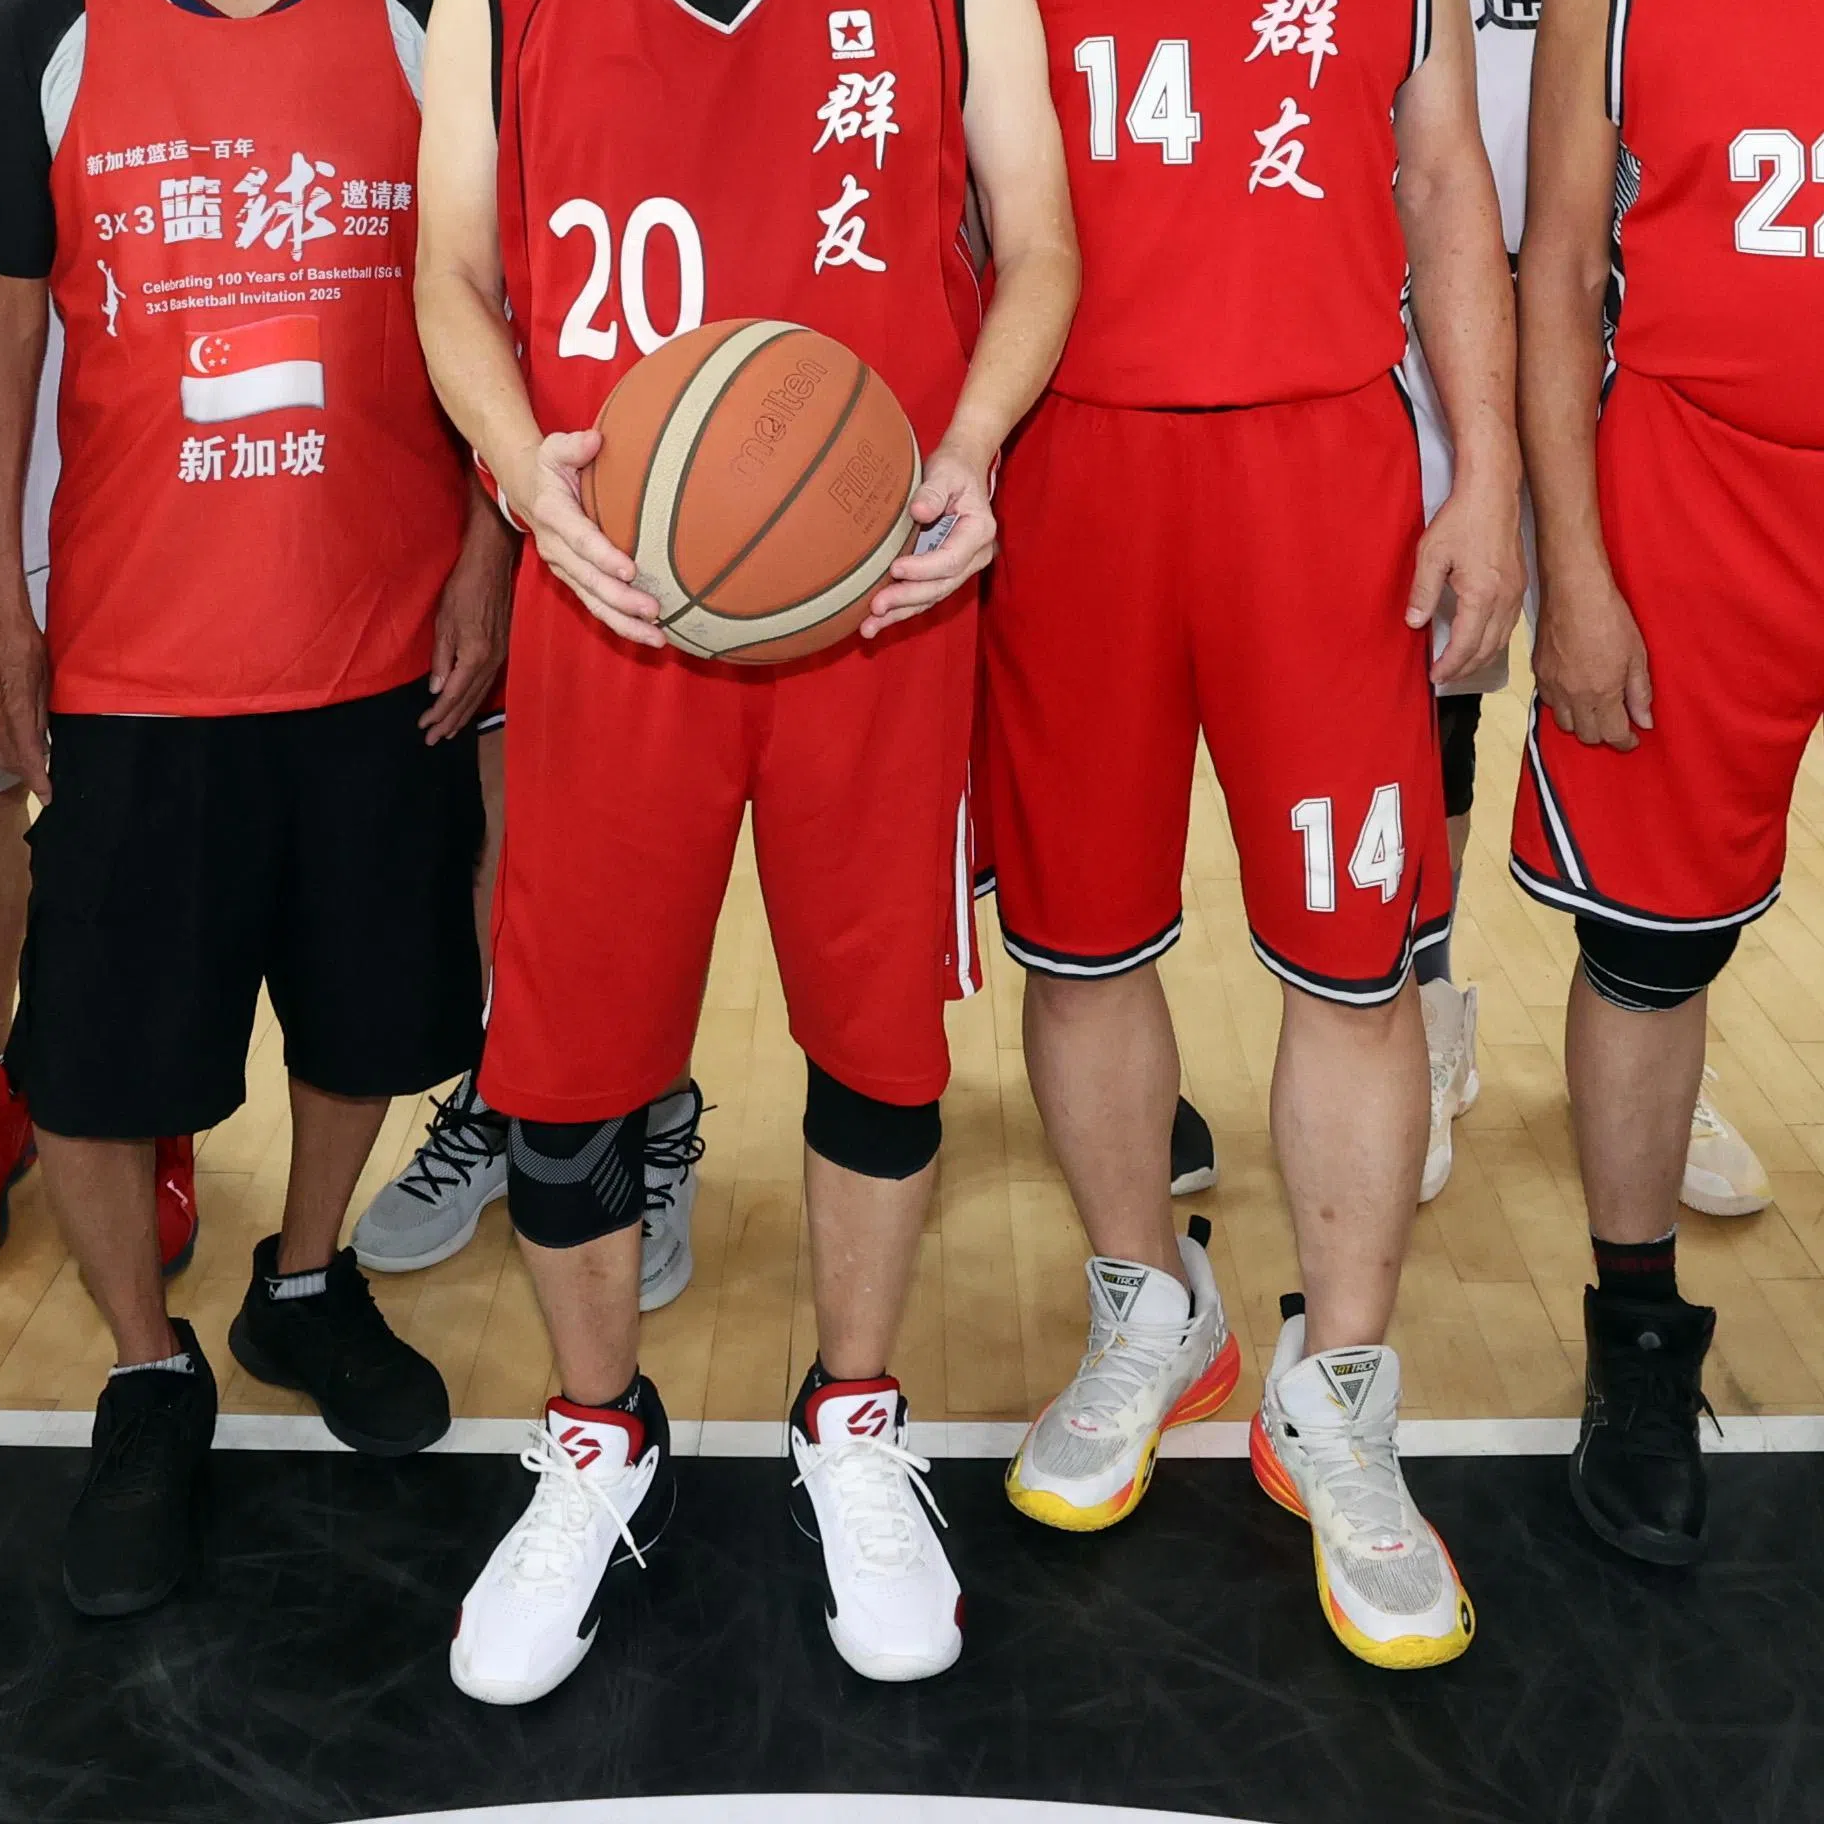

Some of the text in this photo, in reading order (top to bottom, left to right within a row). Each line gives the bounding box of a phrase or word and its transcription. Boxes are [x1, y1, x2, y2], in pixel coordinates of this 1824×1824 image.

[1073, 34, 1201, 166] 14
[86, 137, 255, 176] 新加坡篮运一百年
[160, 151, 337, 262] 篮球
[340, 179, 413, 212] 邀请赛
[343, 216, 390, 237] 2025
[142, 275, 213, 296] Celebrating
[217, 272, 242, 287] 100
[246, 270, 286, 284] Years
[289, 269, 304, 283] of
[307, 266, 372, 282] Basketball
[145, 286, 342, 316] 3x3 Basketball Invitation 2025
[549, 196, 705, 362] 20
[178, 429, 328, 483] 新加坡
[1290, 782, 1406, 913] 14
